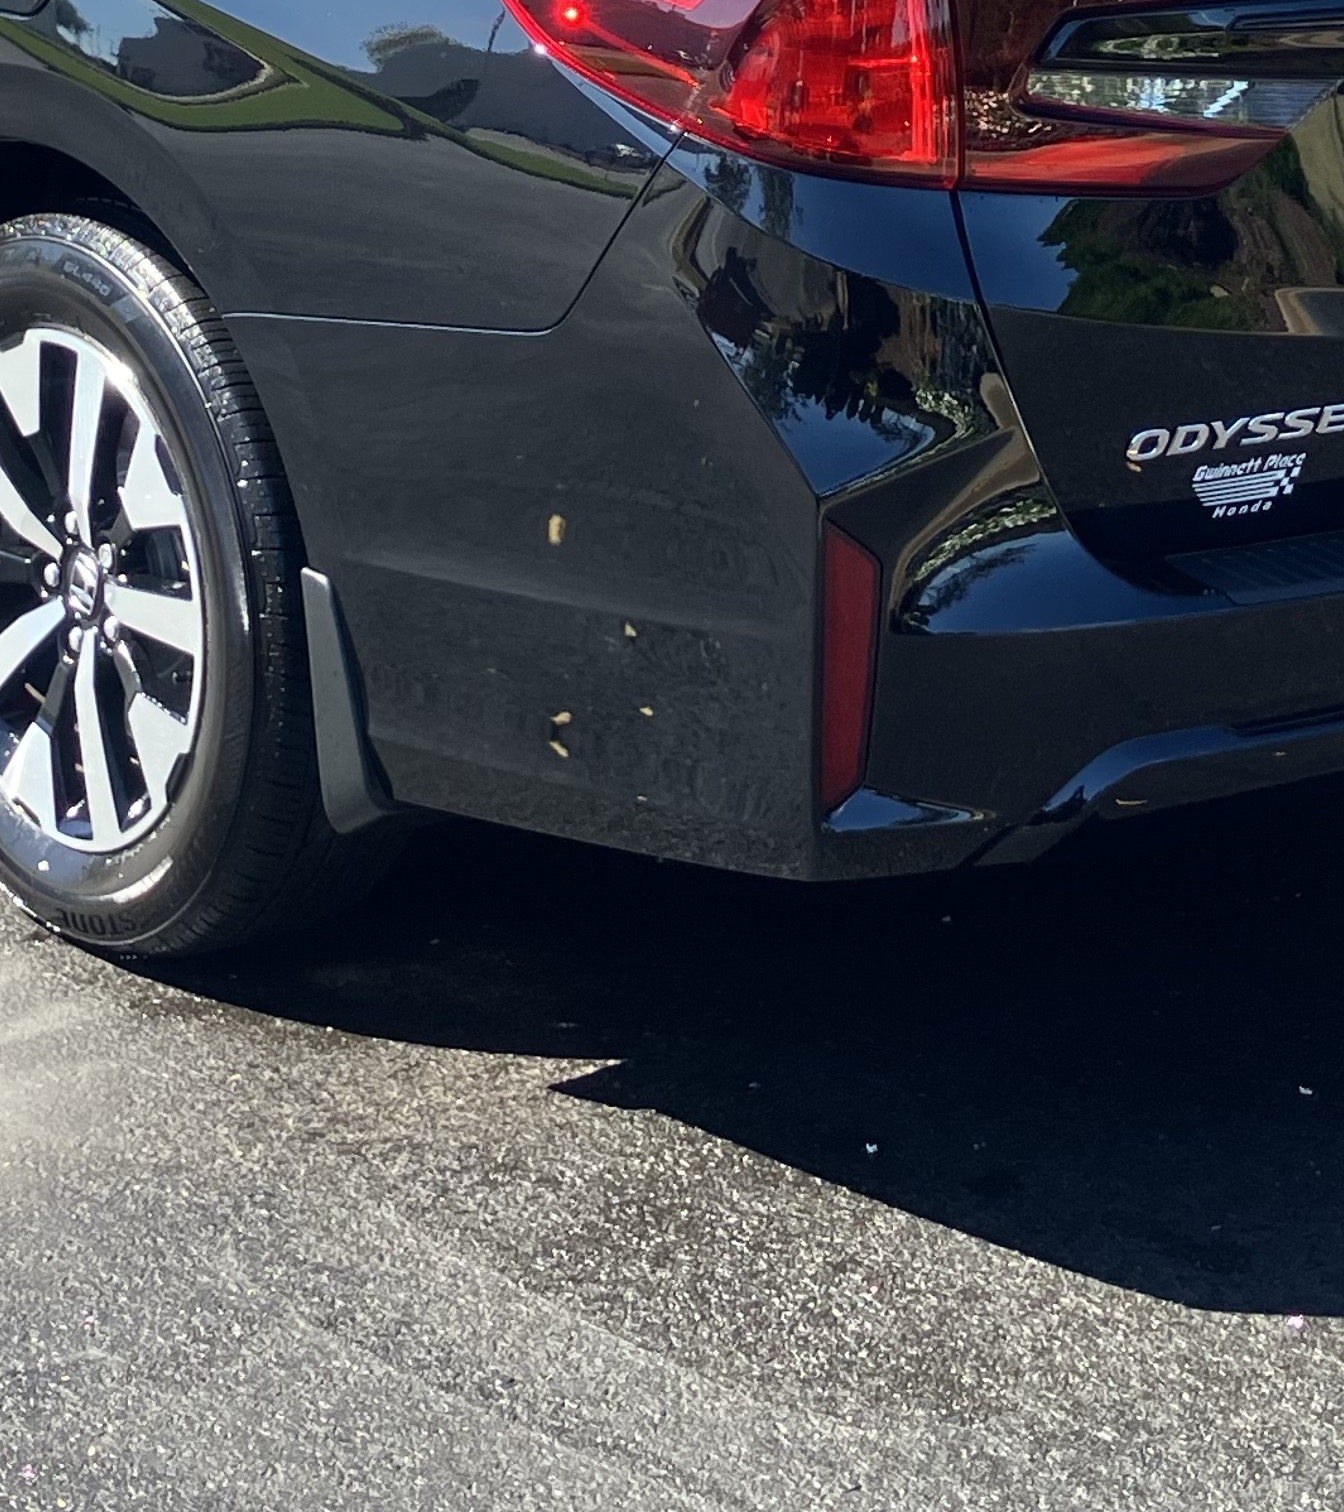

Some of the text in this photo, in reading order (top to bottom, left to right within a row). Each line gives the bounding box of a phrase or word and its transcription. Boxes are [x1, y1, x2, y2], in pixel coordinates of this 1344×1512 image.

[1192, 452, 1306, 482] Gwinnett Place
[1211, 500, 1273, 519] Honda
